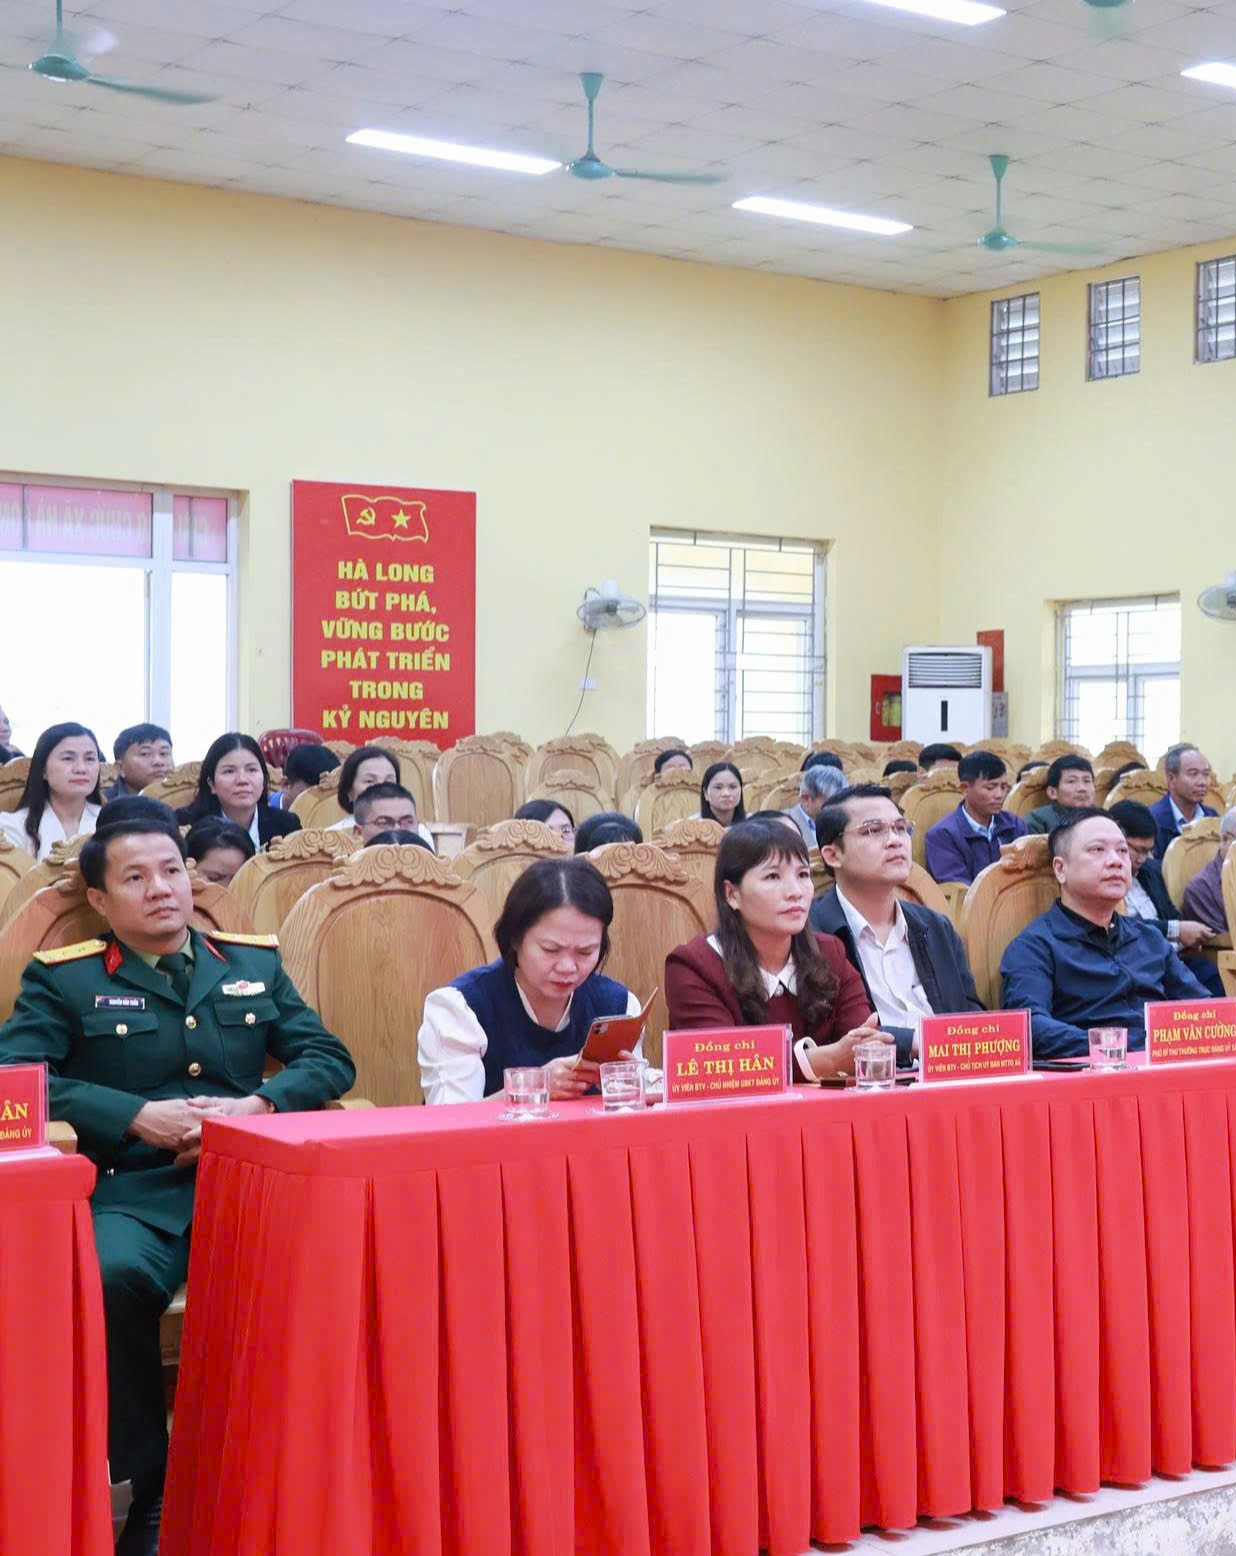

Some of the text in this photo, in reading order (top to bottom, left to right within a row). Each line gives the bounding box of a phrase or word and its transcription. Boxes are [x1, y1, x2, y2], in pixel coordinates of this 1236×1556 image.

[337, 557, 435, 584] HÀ LONG
[335, 587, 437, 615] BỨT PHÁ,
[321, 617, 450, 642] VỮNG BƯỚC
[320, 645, 451, 671] PHÁT TRIỂN
[349, 679, 424, 700] TRONG
[322, 703, 449, 730] KỶ NGUYÊN
[1173, 1009, 1217, 1021] Đồng chí
[946, 1024, 1000, 1036] Đồng chí
[1153, 1020, 1236, 1045] PHẠM VĂN CƯỜNG
[694, 1039, 755, 1053] Đồng chí
[928, 1037, 1020, 1058] MAI THỊ PHƯỢNG
[676, 1053, 775, 1077] LÊ THỊ HÂN
